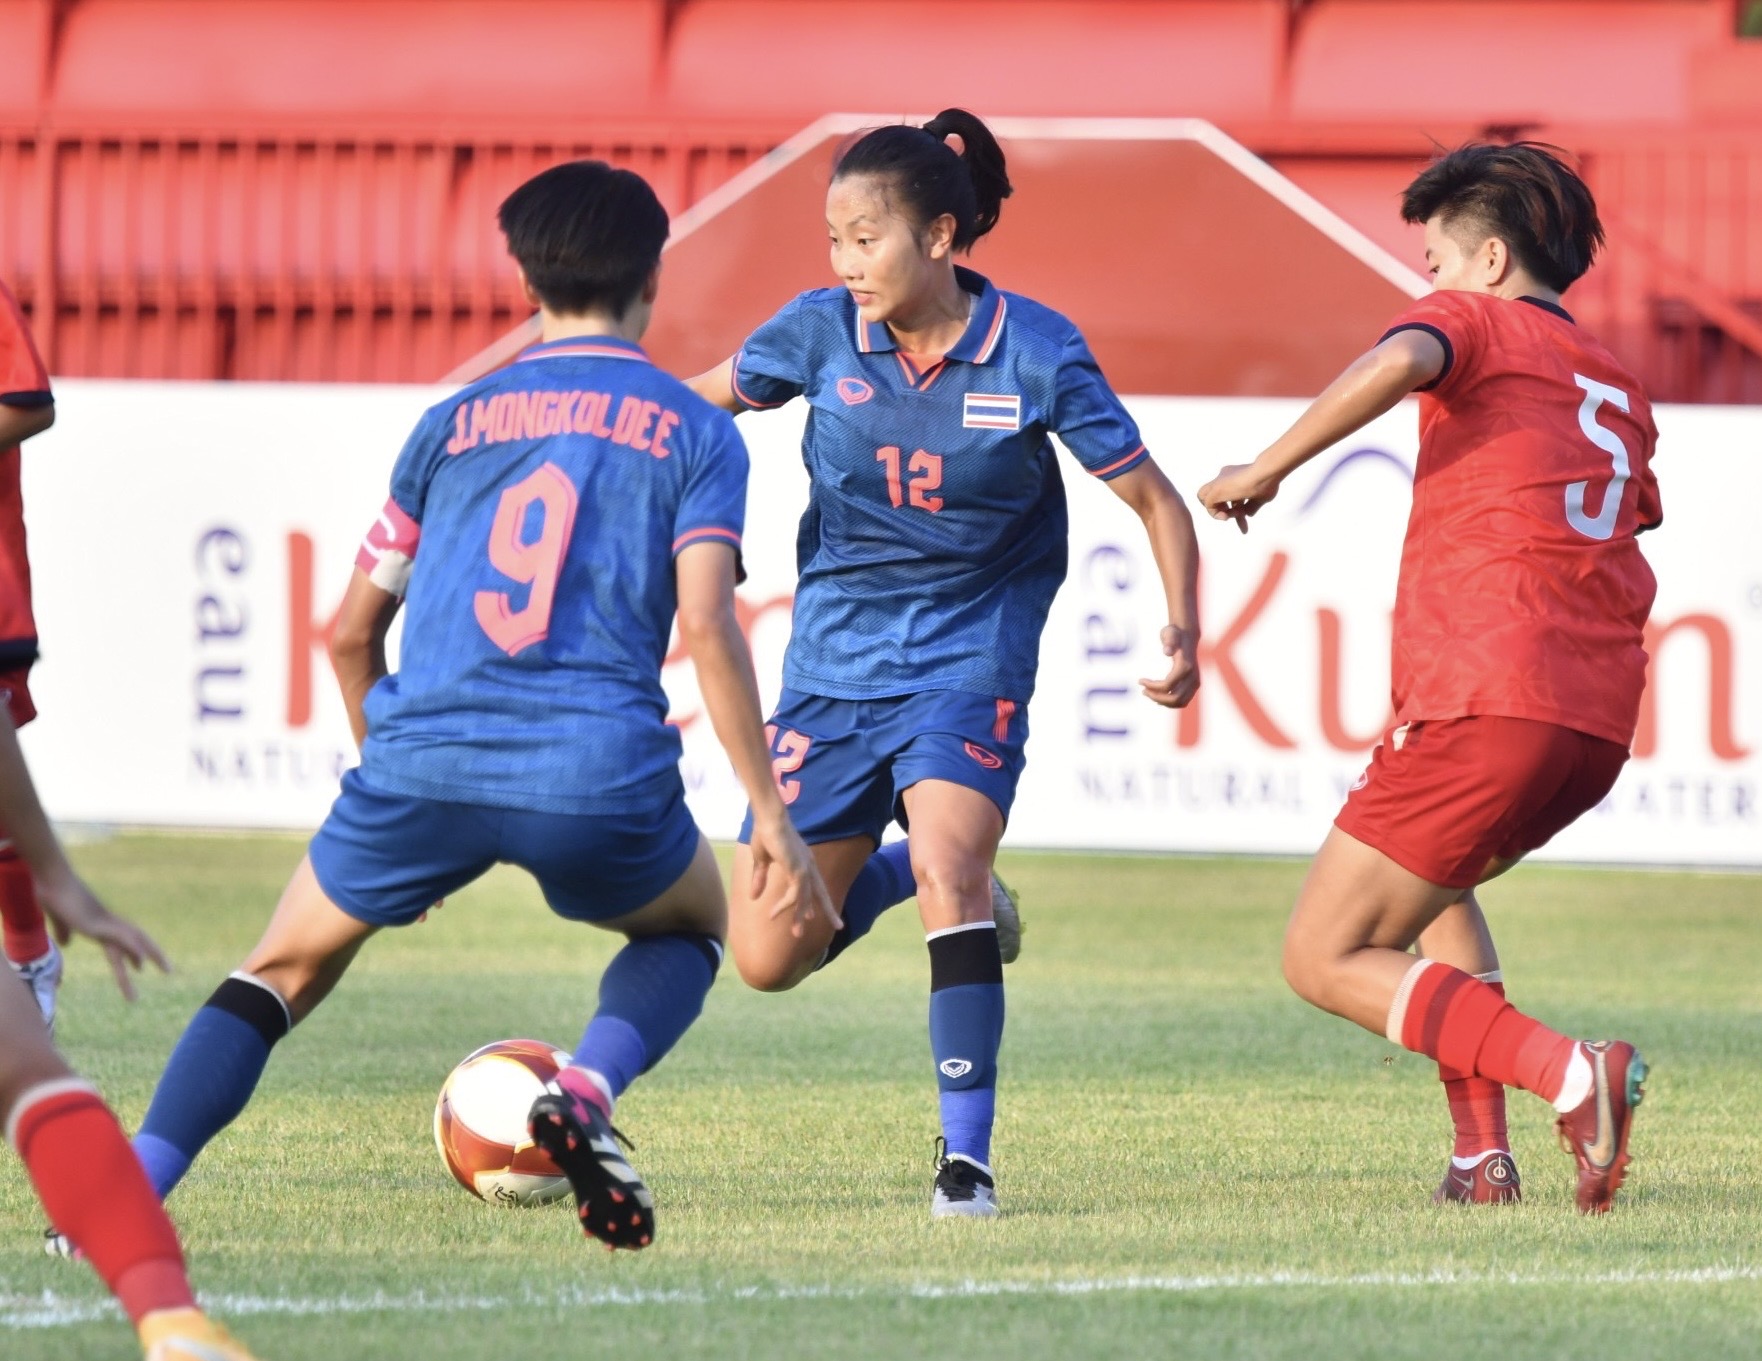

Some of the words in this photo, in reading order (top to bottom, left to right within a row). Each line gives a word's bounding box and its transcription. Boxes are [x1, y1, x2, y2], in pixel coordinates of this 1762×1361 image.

[447, 391, 680, 458] J.MONGKOLDEE
[1564, 373, 1632, 540] 5
[876, 446, 944, 513] 12
[474, 462, 578, 656] 9
[1176, 552, 1754, 761] Kun
[764, 725, 811, 804] 2
[1594, 781, 1757, 826] ATER
